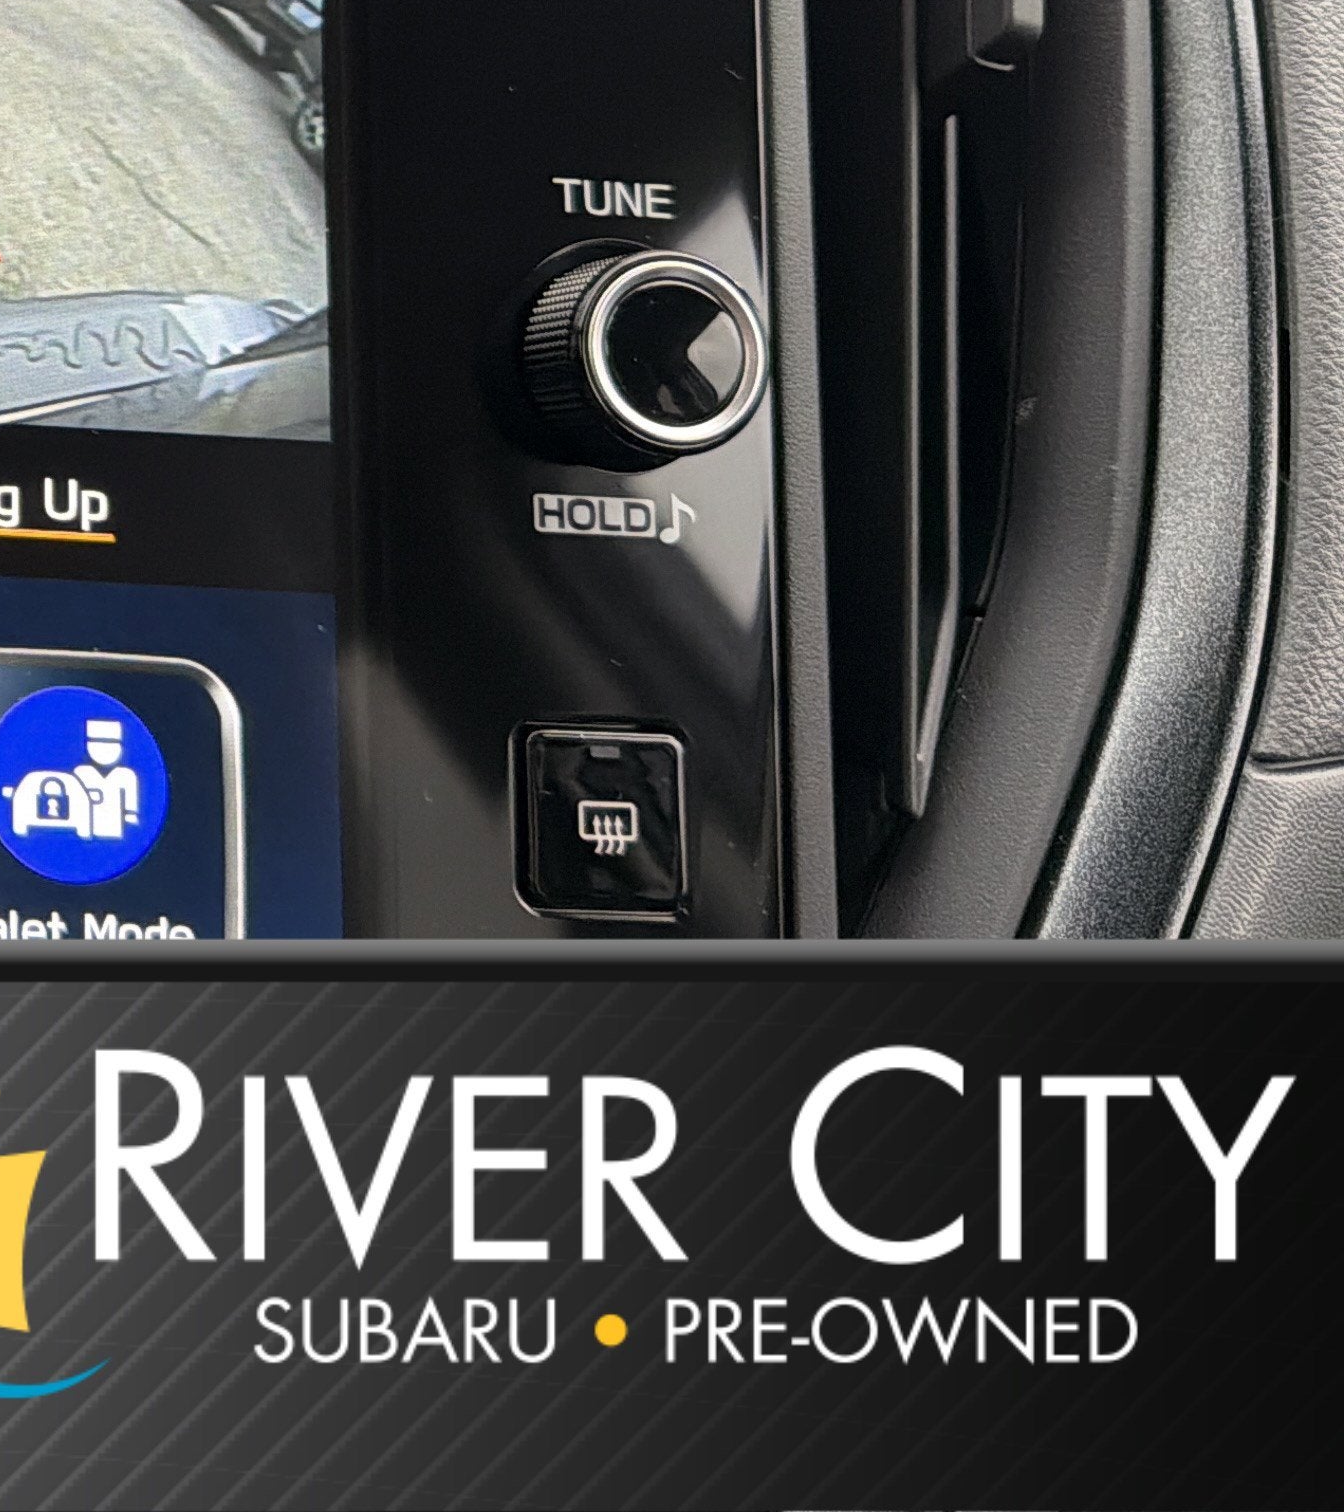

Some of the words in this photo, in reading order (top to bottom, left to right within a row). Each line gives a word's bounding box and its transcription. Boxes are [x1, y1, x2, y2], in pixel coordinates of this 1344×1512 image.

[552, 177, 677, 220] TUNE
[43, 476, 110, 530] Up
[535, 495, 654, 536] HOLD
